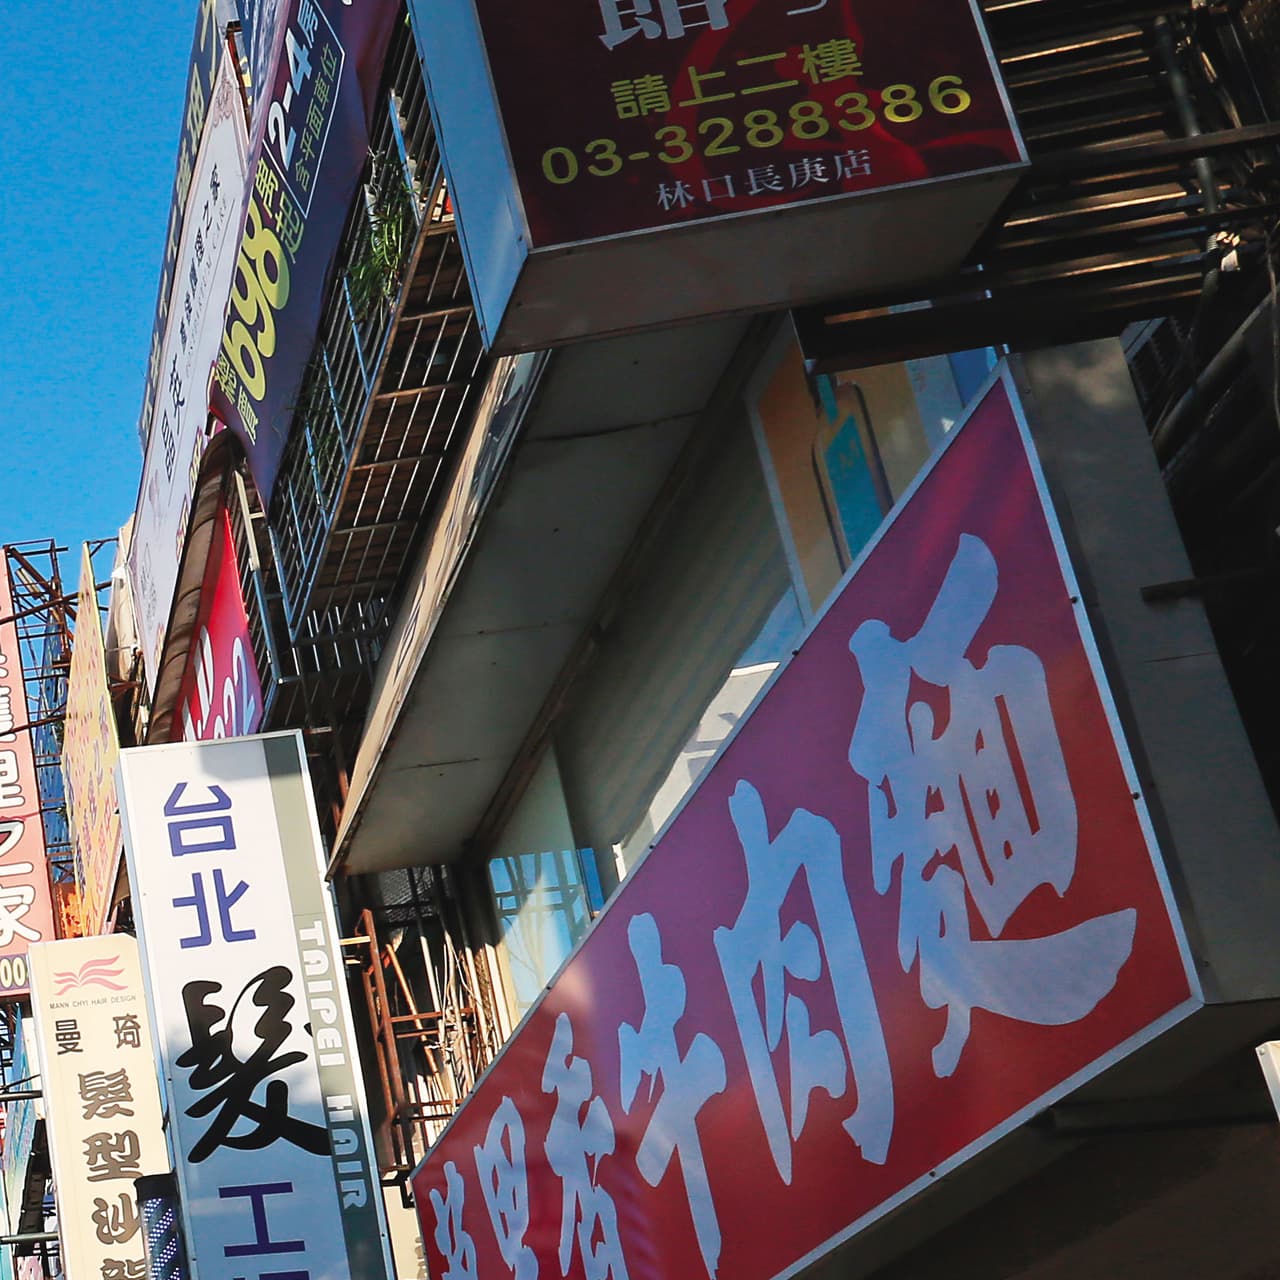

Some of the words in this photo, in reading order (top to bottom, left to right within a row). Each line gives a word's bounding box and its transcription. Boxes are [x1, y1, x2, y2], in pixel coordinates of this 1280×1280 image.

[296, 42, 338, 193] 含平面車位
[610, 39, 864, 119] 請上二樓
[542, 75, 972, 184] 03-3288386
[656, 149, 872, 211] 林口長庚店
[50, 1001, 70, 1010] MANN
[91, 997, 108, 1006] HAIR
[110, 994, 136, 1004] DESIGN
[298, 919, 347, 1066] TAIPEI
[326, 1093, 368, 1210] HAIR
